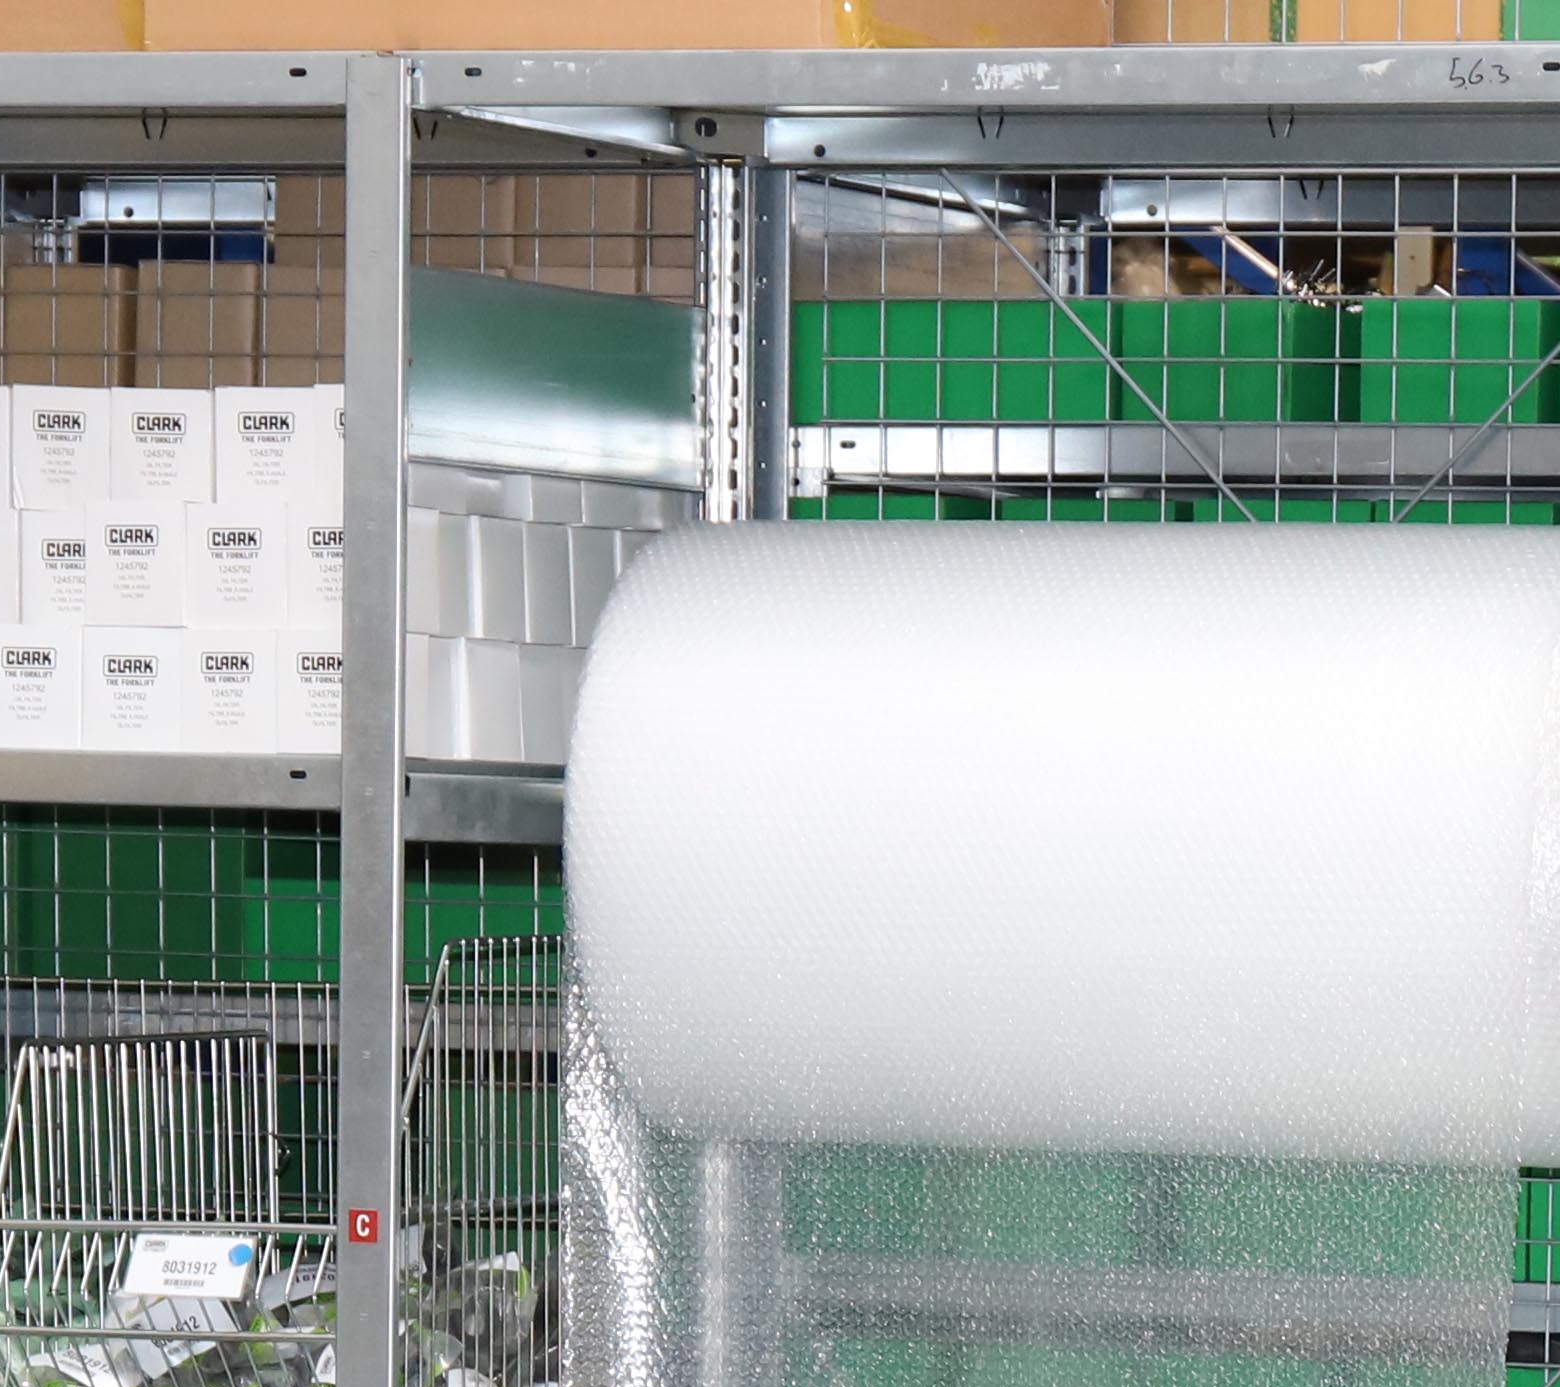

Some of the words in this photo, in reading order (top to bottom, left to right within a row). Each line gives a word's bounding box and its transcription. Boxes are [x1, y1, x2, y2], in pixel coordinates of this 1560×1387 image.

[37, 413, 81, 429] CLARK
[137, 416, 182, 432] CLARK
[242, 415, 289, 430] CLARK
[109, 528, 154, 544] CLARK
[212, 531, 257, 547] CLARK
[46, 543, 85, 558] CLAR
[6, 651, 52, 666] CLARK
[108, 659, 153, 674] CLARK
[205, 655, 249, 671] CLARK
[356, 1213, 371, 1237] C
[162, 1259, 217, 1276] 8031912
